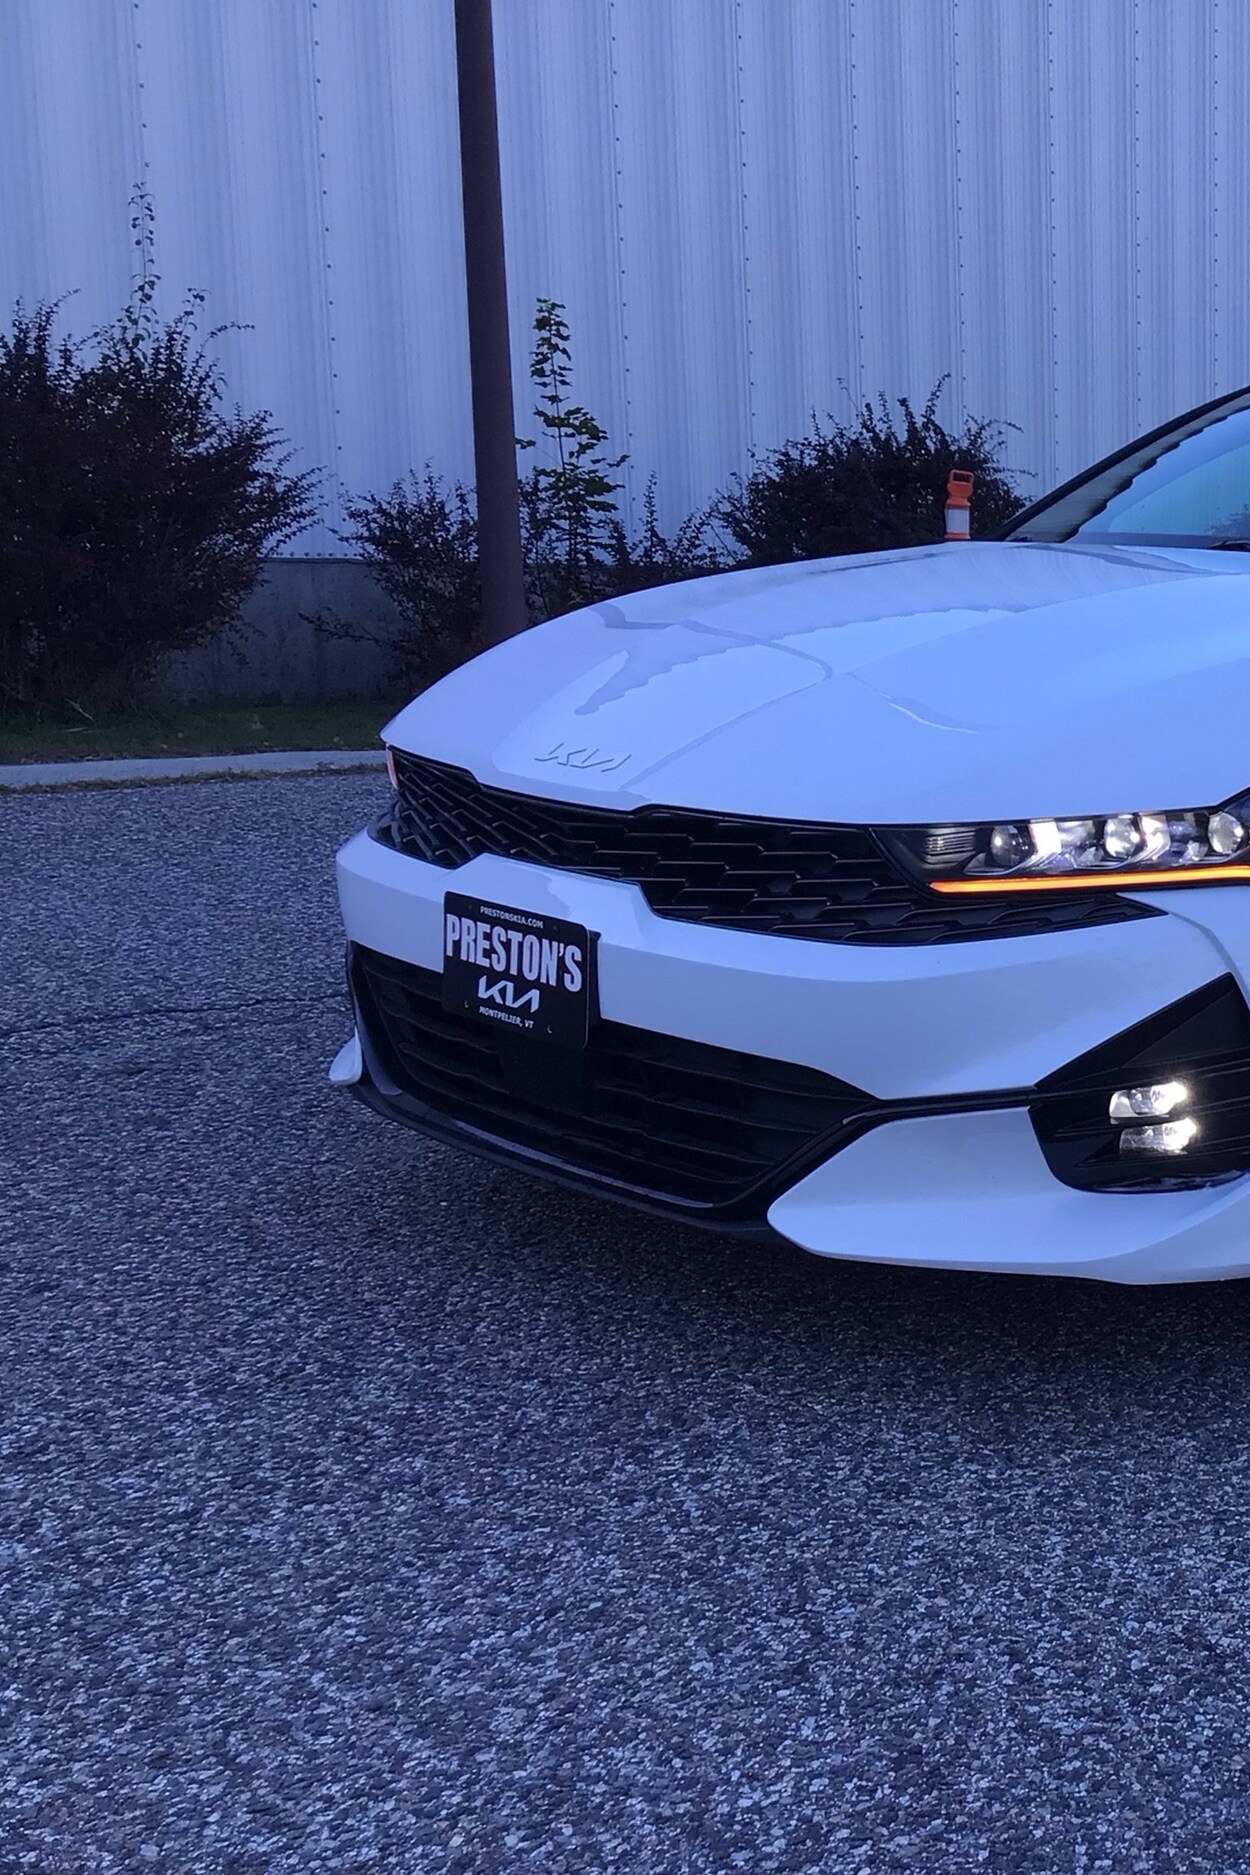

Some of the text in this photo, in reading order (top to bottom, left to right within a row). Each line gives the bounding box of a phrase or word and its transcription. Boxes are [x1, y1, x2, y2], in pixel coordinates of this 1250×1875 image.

[480, 905, 544, 929] PRESTONSKIA.COM
[446, 913, 582, 992] PRESTON'S
[478, 975, 540, 1013] KIA
[479, 1006, 534, 1029] MONTPELIER, VT
